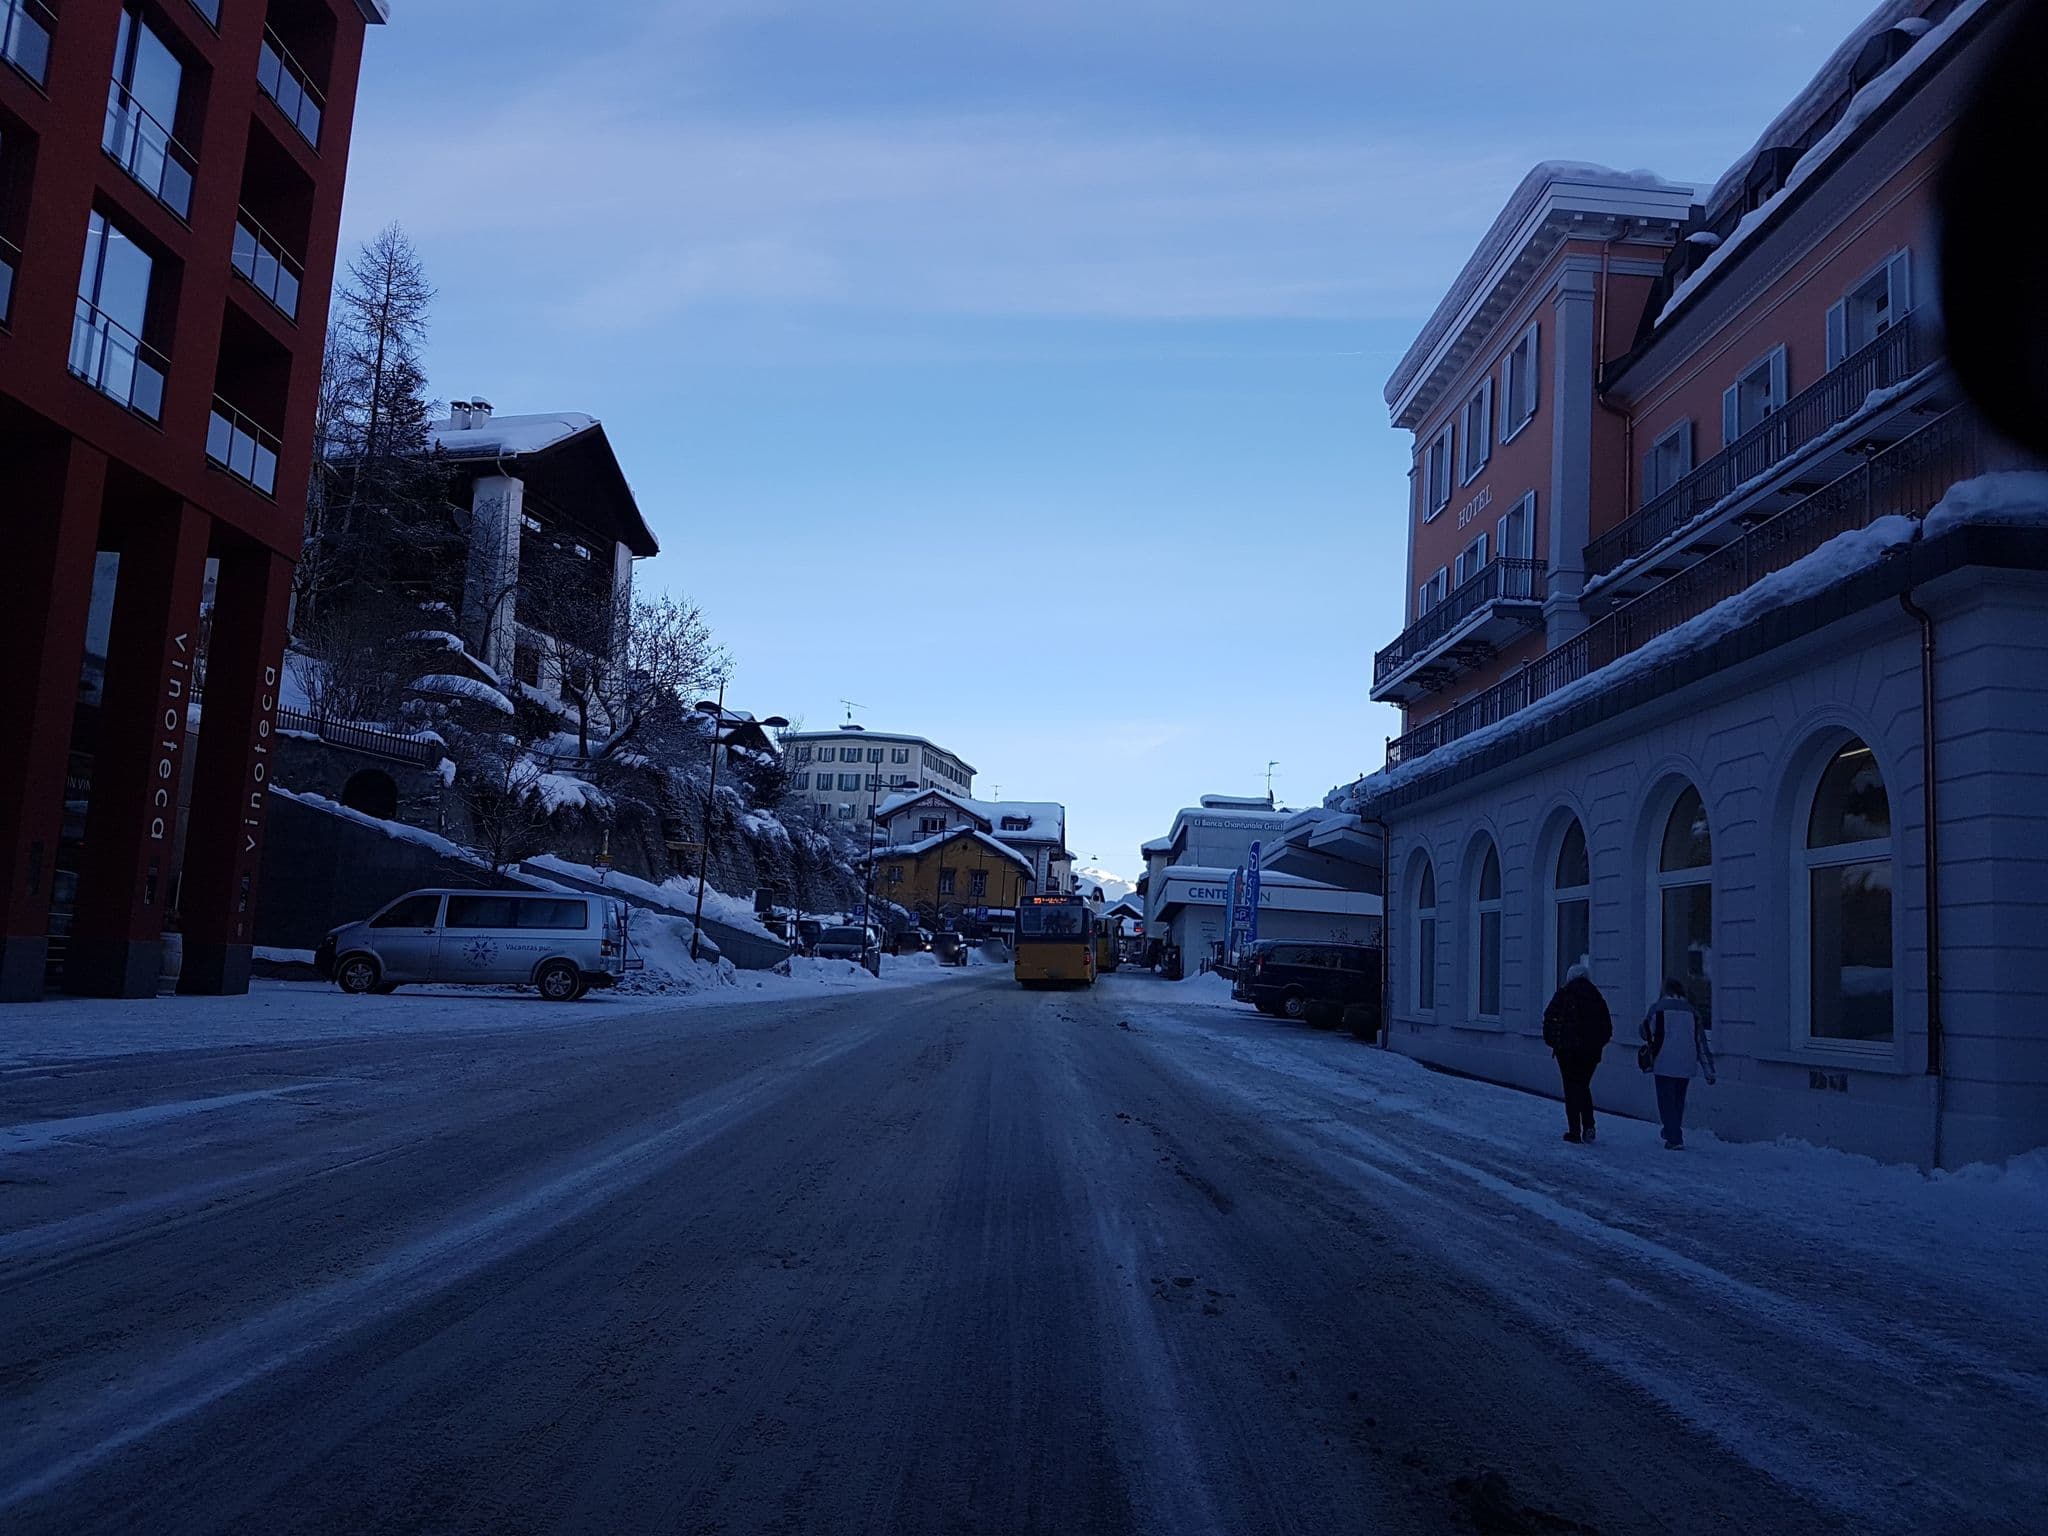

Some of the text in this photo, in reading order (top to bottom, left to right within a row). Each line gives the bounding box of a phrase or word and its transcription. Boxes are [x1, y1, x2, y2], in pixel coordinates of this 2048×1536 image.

[1457, 484, 1493, 531] HOTEL
[151, 633, 188, 839] vinoteca
[245, 666, 276, 852] vinoteca
